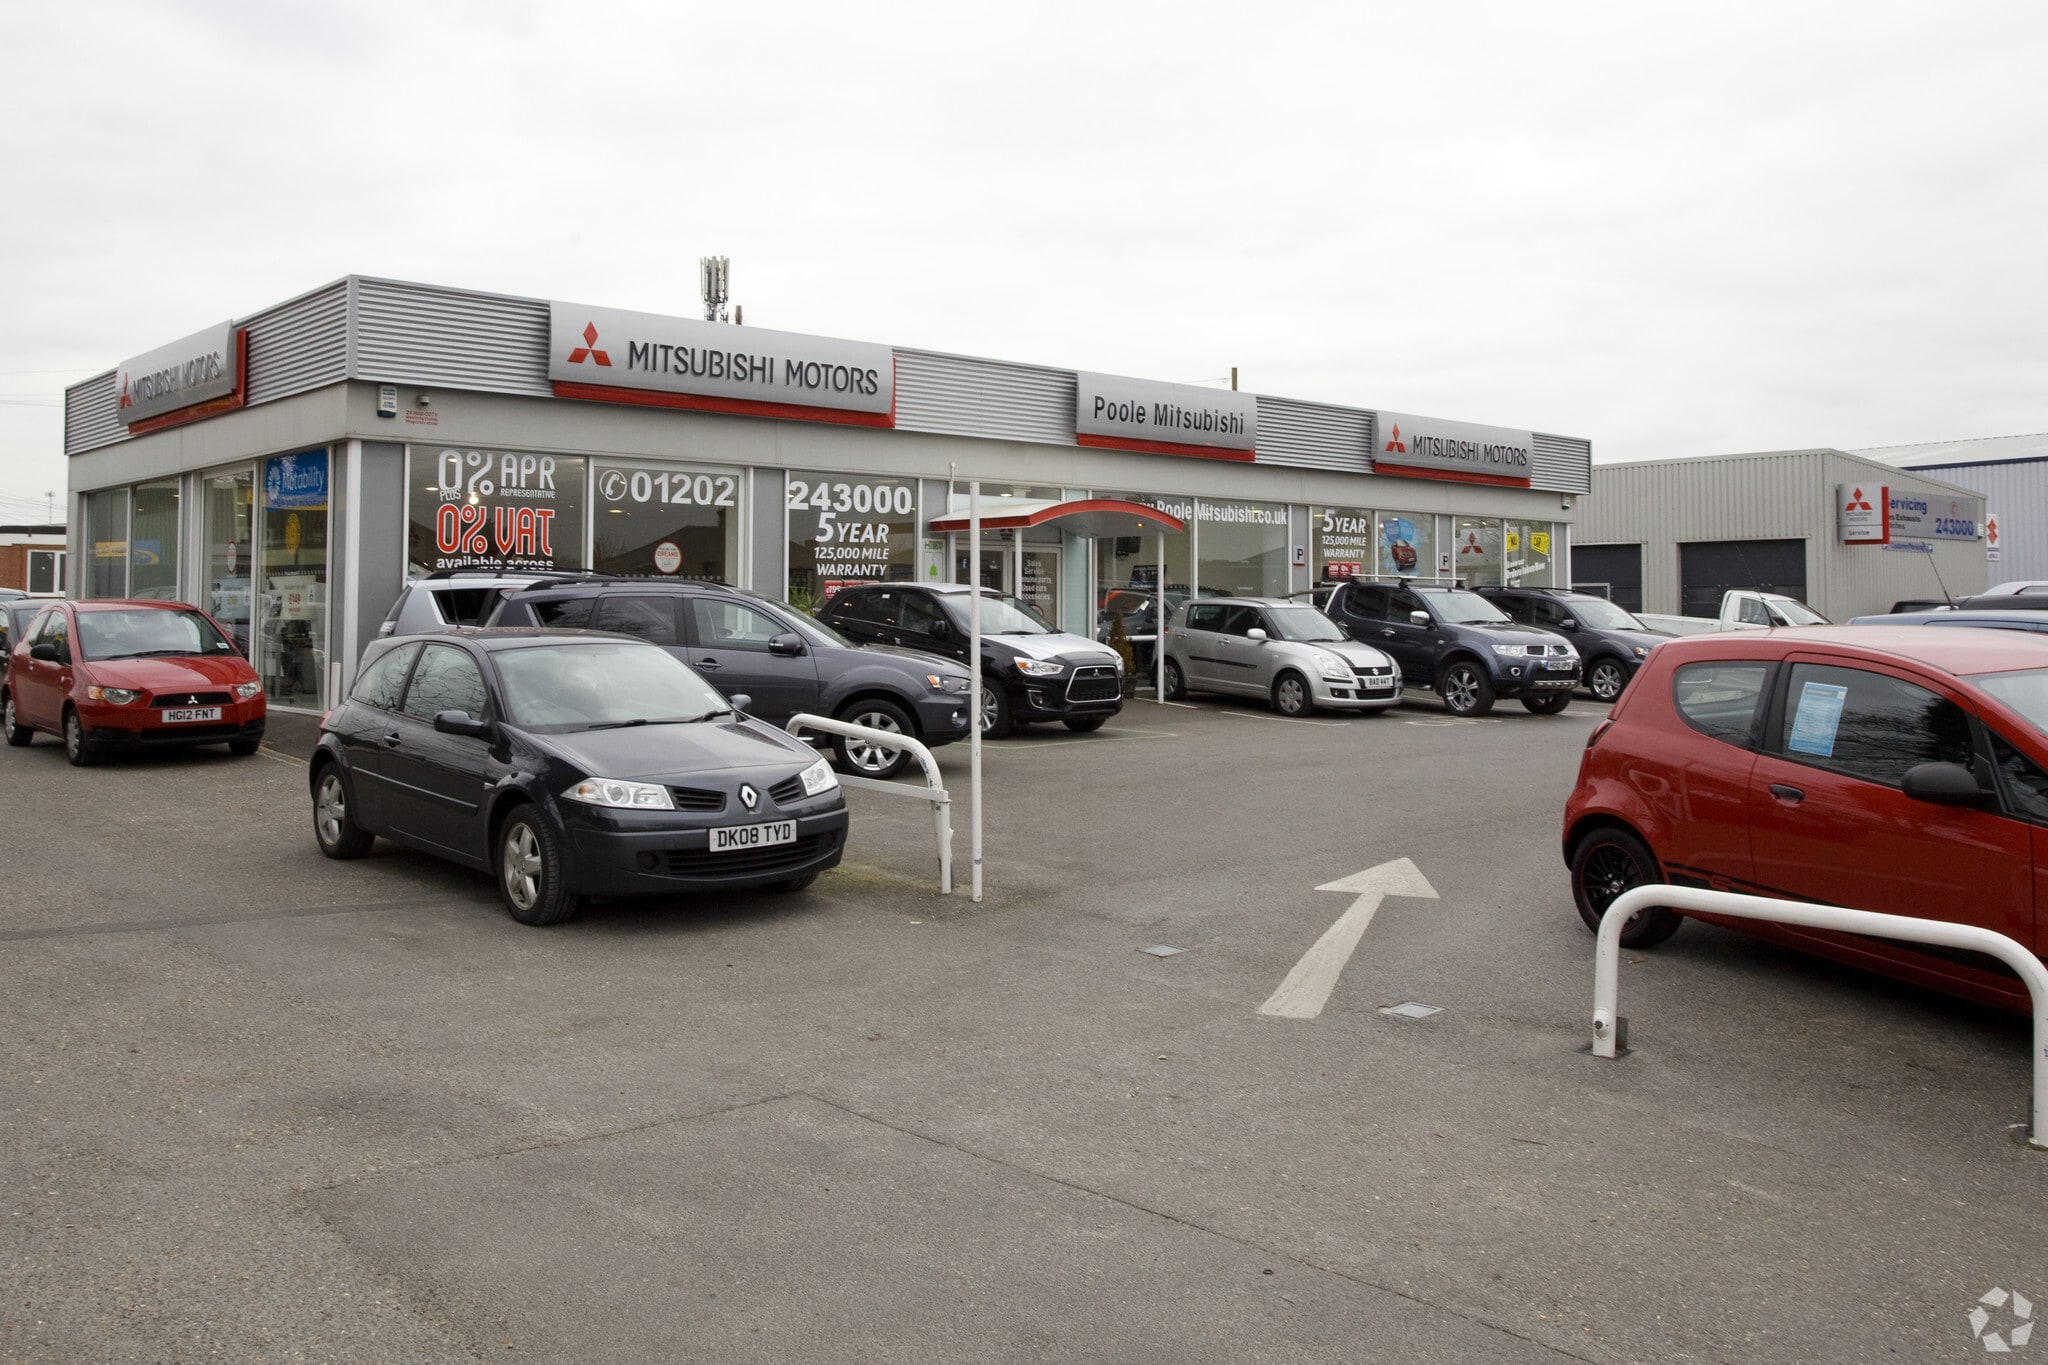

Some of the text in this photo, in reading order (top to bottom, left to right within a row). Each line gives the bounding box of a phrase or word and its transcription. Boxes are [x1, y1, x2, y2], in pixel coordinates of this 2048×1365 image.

[628, 339, 878, 395] MITSUBISHI MOTORS
[133, 351, 221, 405] MITSUBISHI MOTORS
[1094, 395, 1244, 434] Poole Mitsubishi
[1413, 435, 1527, 466] MITSUBISHI MOTORS
[438, 450, 556, 495] 0% APR
[440, 488, 461, 501] PLUS
[500, 488, 556, 499] REPRESENTATIVE
[630, 471, 735, 506] 01202
[789, 480, 912, 514] 243000
[1890, 497, 1928, 514] ervicing
[437, 503, 555, 556] 0% VAT
[815, 512, 890, 543] 5 YEAR
[1322, 509, 1335, 532] 5
[1334, 517, 1366, 533] YEAR
[1936, 518, 1974, 537] 243000
[1322, 535, 1367, 546] 125,000 MILE
[436, 555, 502, 569] available
[814, 547, 890, 561] 125,000 MILE
[1296, 548, 1304, 560] P
[1323, 548, 1365, 559] WARRANTY
[1443, 555, 1449, 566] P
[816, 563, 887, 576] WARRANTY
[168, 708, 216, 721] HG12 FNT
[717, 823, 791, 848] DK08 TYD
